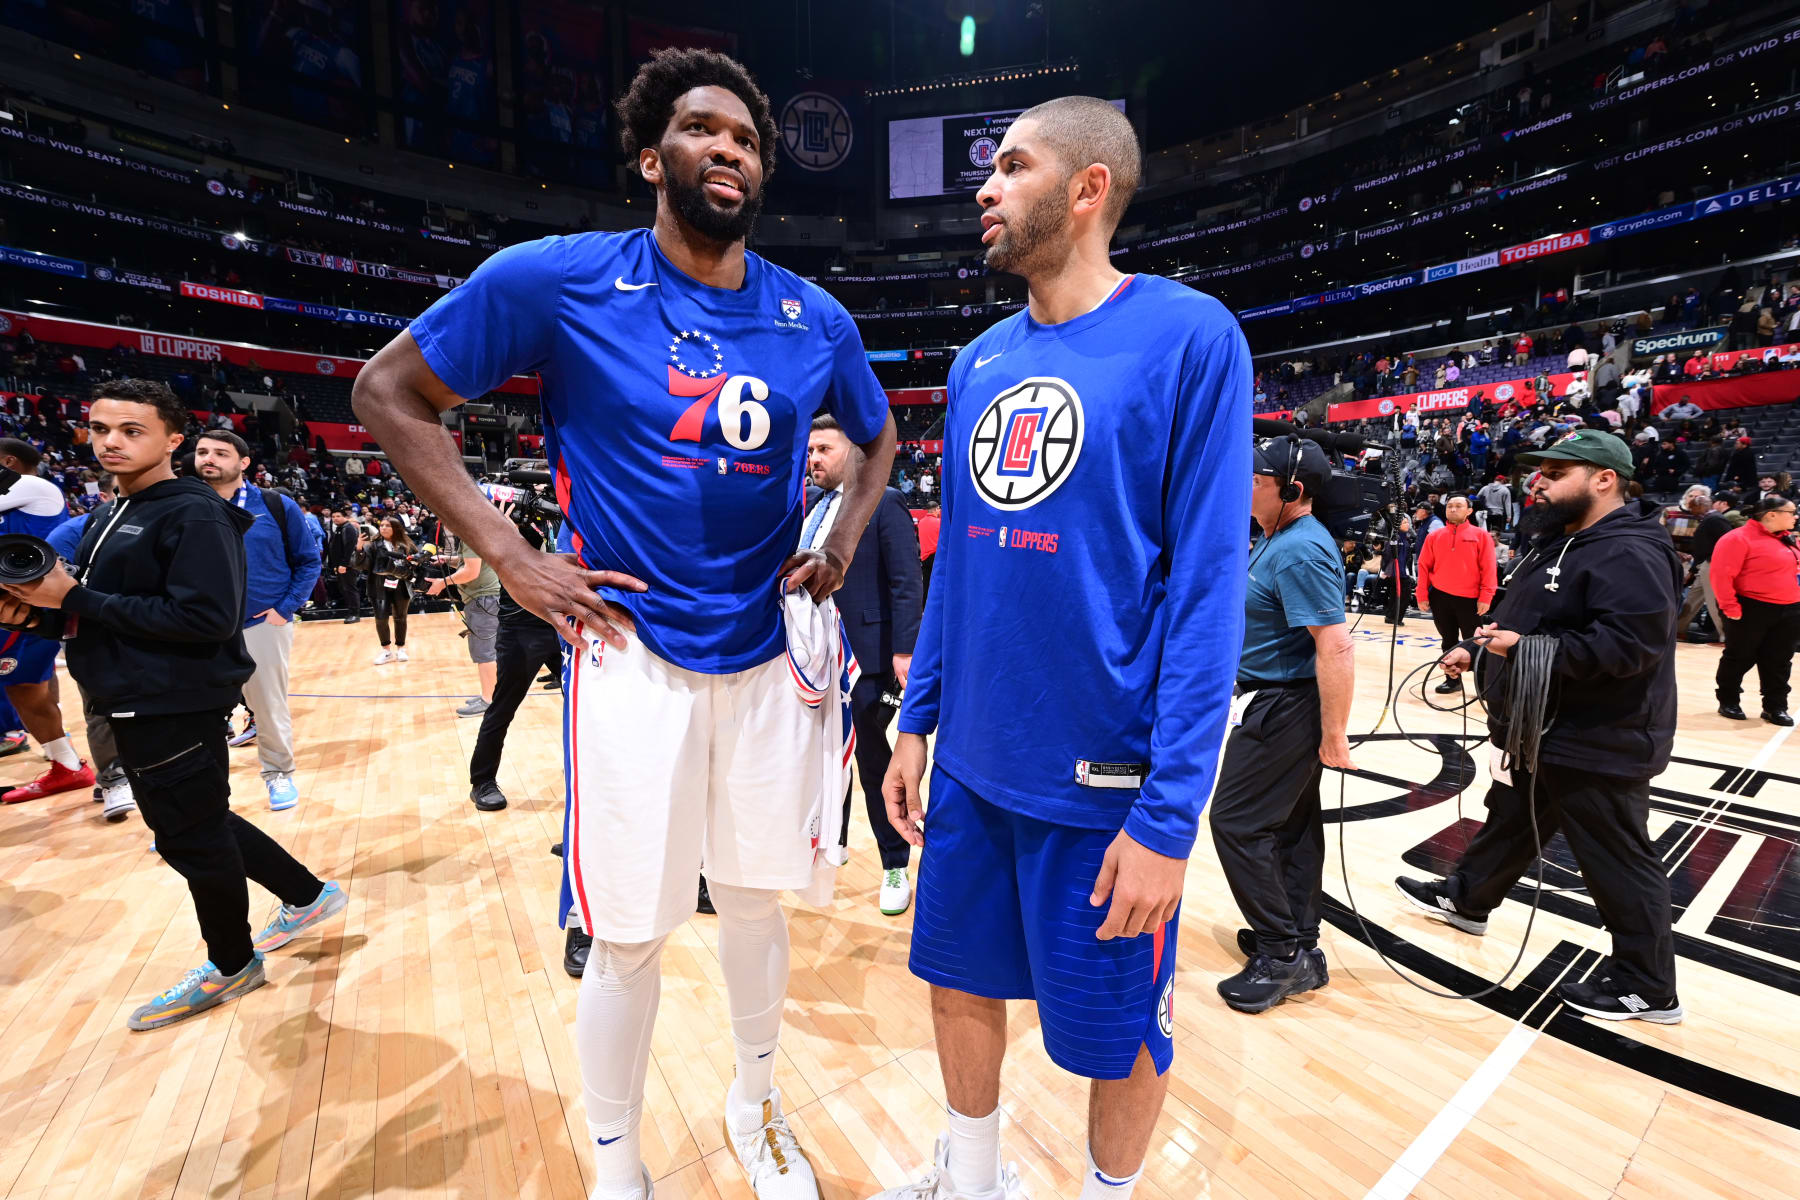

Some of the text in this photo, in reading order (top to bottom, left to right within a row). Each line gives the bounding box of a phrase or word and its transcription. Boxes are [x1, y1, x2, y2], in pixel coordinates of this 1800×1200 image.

[1589, 96, 1615, 111] VISIT
[1619, 62, 1710, 101] CLIPPERS.COM
[1714, 53, 1735, 67] OR
[1738, 38, 1779, 58] VIVID
[964, 126, 1010, 137] NEXT HOM
[1514, 112, 1573, 137] vividseats
[1593, 156, 1621, 170] VISIT
[1624, 127, 1719, 161] CLIPPERS.COM
[1722, 119, 1744, 133] OR
[1747, 105, 1789, 124] VIVID
[27, 134, 47, 145] OR
[48, 139, 84, 155] VIVID
[87, 150, 122, 166] SEATS
[150, 167, 191, 184] TICKETS
[960, 169, 992, 177] THURSDAY
[1353, 172, 1399, 192] THURSDAY
[1405, 164, 1424, 176] JAN
[1426, 160, 1437, 169] 26
[1445, 150, 1465, 162] 7:30
[228, 186, 245, 199] VS
[1510, 173, 1568, 196] vividseats
[1314, 194, 1327, 205] VS
[51, 198, 70, 208] OR
[72, 203, 107, 217] VIVID
[109, 211, 145, 226] SEATS
[172, 225, 212, 241] TICKETS
[279, 200, 328, 217] THURSDAY
[335, 214, 353, 223] JAN
[355, 217, 366, 226] 26
[372, 221, 391, 231] 7:30
[1359, 222, 1404, 240] THURSDAY
[1411, 214, 1430, 226] JAN
[1431, 210, 1443, 220] 26
[1451, 202, 1472, 214] 7:30
[1617, 210, 1683, 232] crypto.com
[1151, 232, 1196, 247] CLIPPERS.COM
[1207, 225, 1225, 234] VIVID
[1226, 220, 1247, 230] SEATS
[1262, 208, 1288, 221] TICKETS
[242, 241, 259, 252] VS
[430, 233, 471, 246] vividseats
[1316, 242, 1329, 252] VS
[1504, 233, 1585, 262] TOSHIBA
[9, 253, 74, 271] crypto.com
[361, 263, 386, 277] 110
[1212, 268, 1230, 277] VIVID
[1231, 263, 1252, 273] SEATS
[1431, 256, 1495, 278] UCLA Health
[115, 275, 172, 292] LA CLIPPERS
[397, 270, 431, 284] Clippers
[1362, 275, 1413, 295] Spectrum
[184, 284, 260, 307] TOSHIBA
[1325, 290, 1352, 302] ULTRA
[303, 304, 336, 317] ULTRA
[359, 314, 402, 327] DELTA
[158, 337, 223, 362] CLIPPERS
[1635, 330, 1718, 353] Spectrum
[667, 364, 771, 450] 76
[1417, 388, 1469, 411] CLIPPERS
[733, 462, 770, 475] 76ERS
[1010, 528, 1059, 553] CLIPPERS
